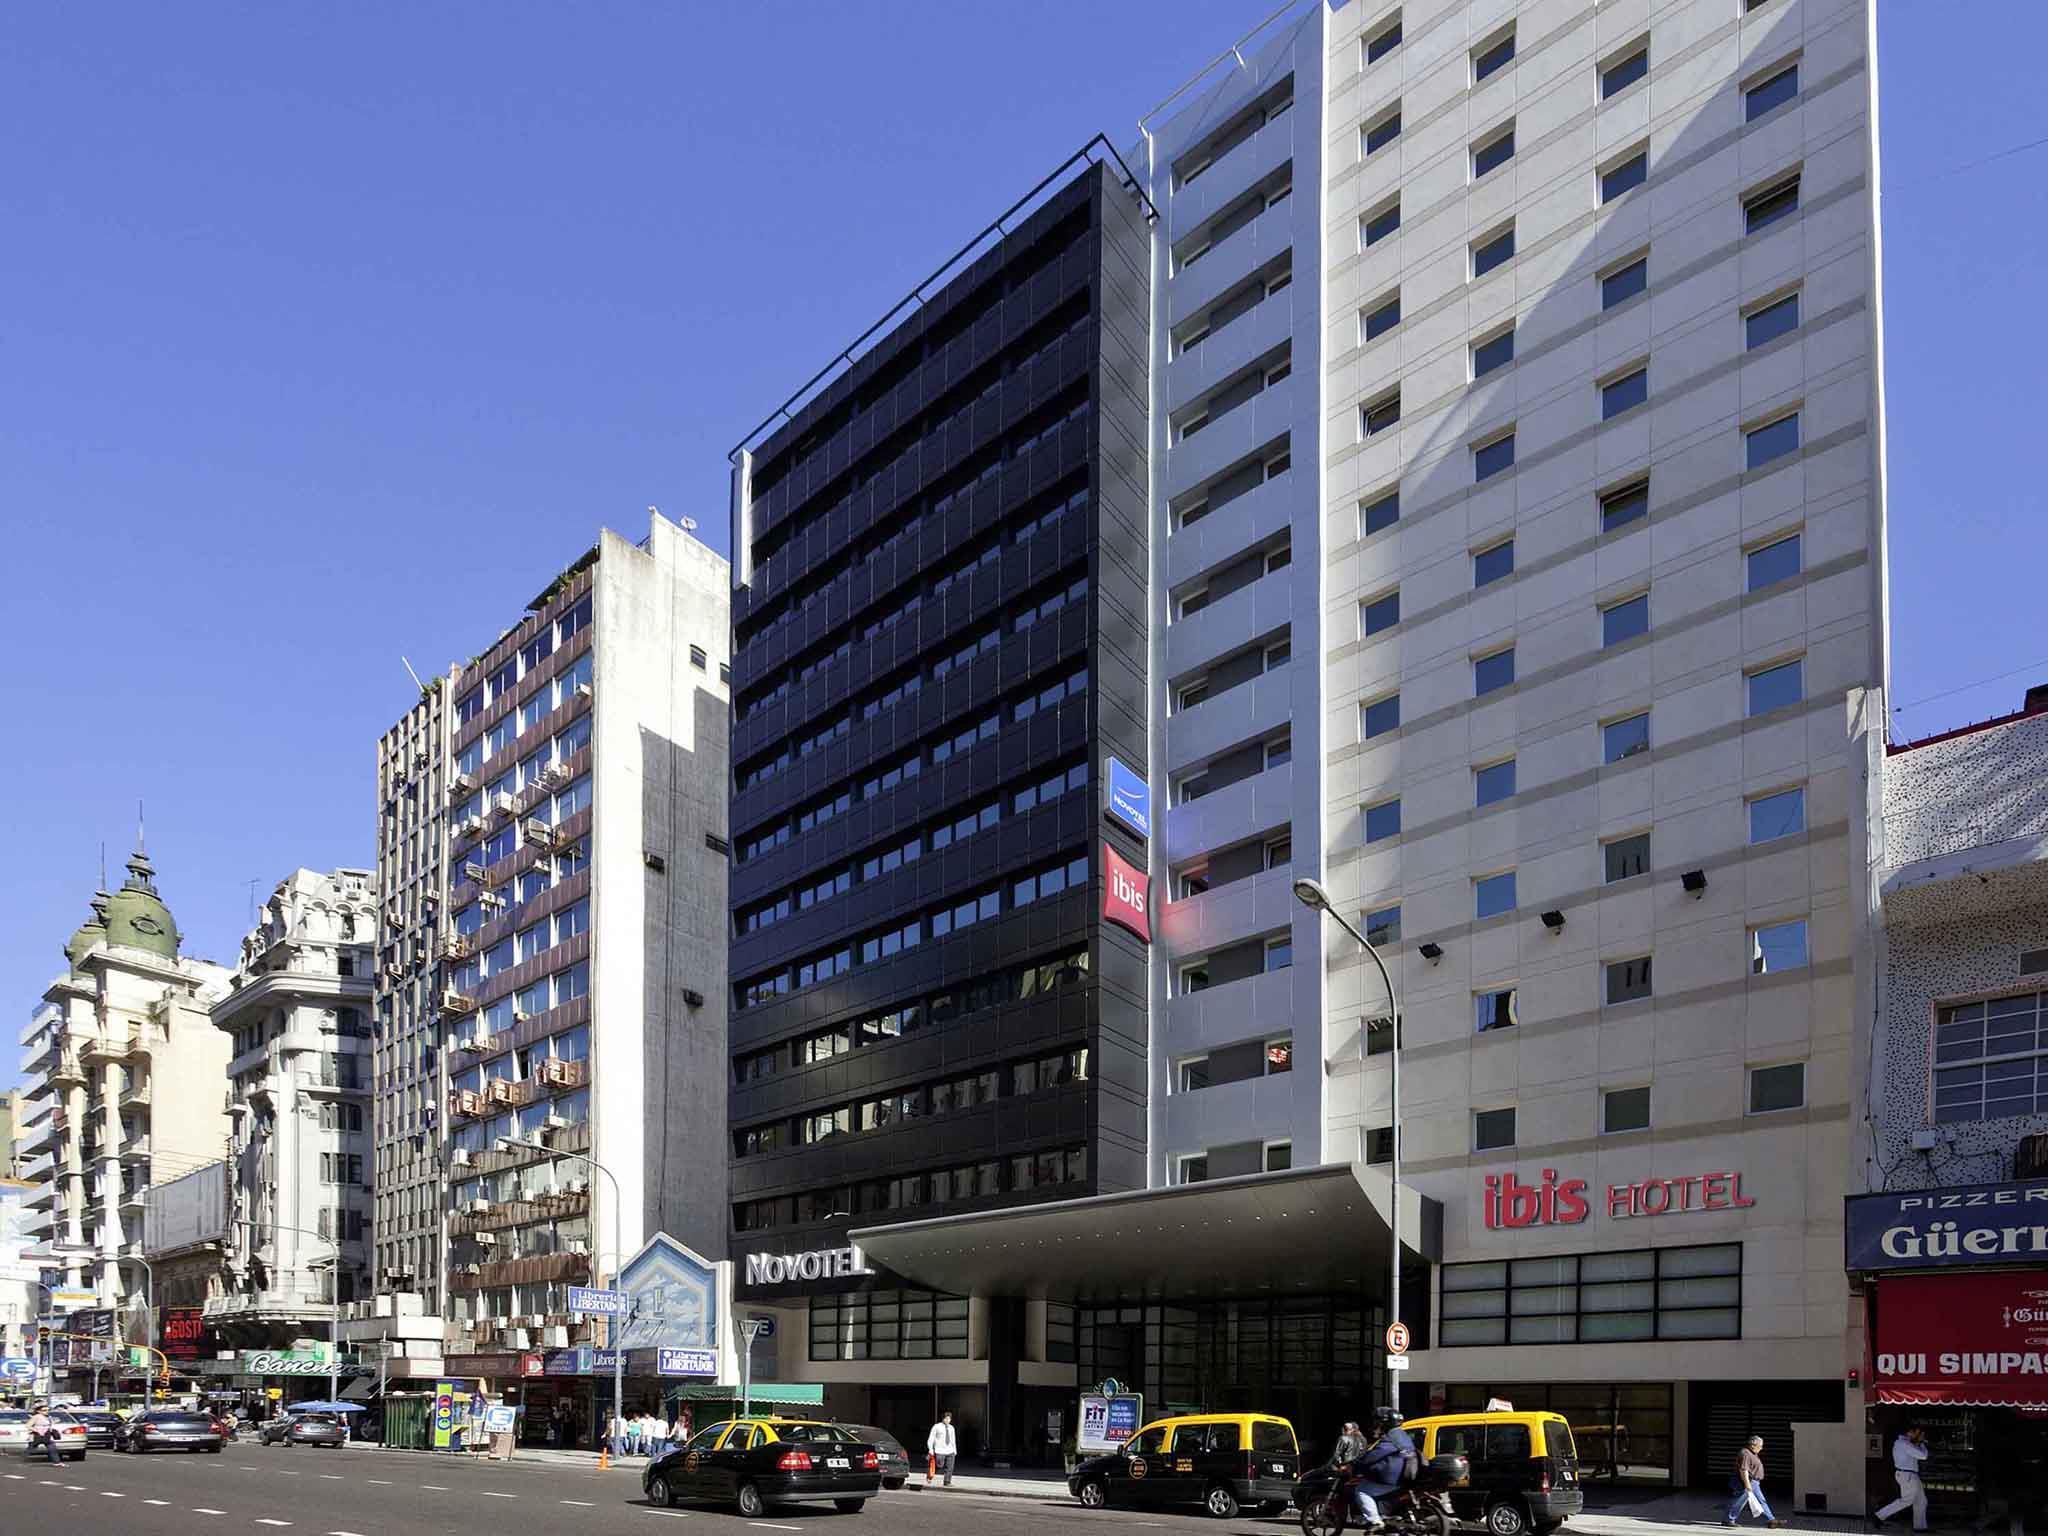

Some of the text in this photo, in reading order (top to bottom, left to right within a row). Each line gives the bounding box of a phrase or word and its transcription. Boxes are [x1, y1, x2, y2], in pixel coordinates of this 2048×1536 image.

[1114, 793, 1146, 825] NOVOTEL
[1113, 871, 1144, 913] ibis
[1484, 1168, 1756, 1229] ibis HOTEL
[746, 1243, 875, 1285] NOVOTEL
[593, 1353, 628, 1366] Librers
[1877, 1353, 2048, 1376] QUI SIMPA
